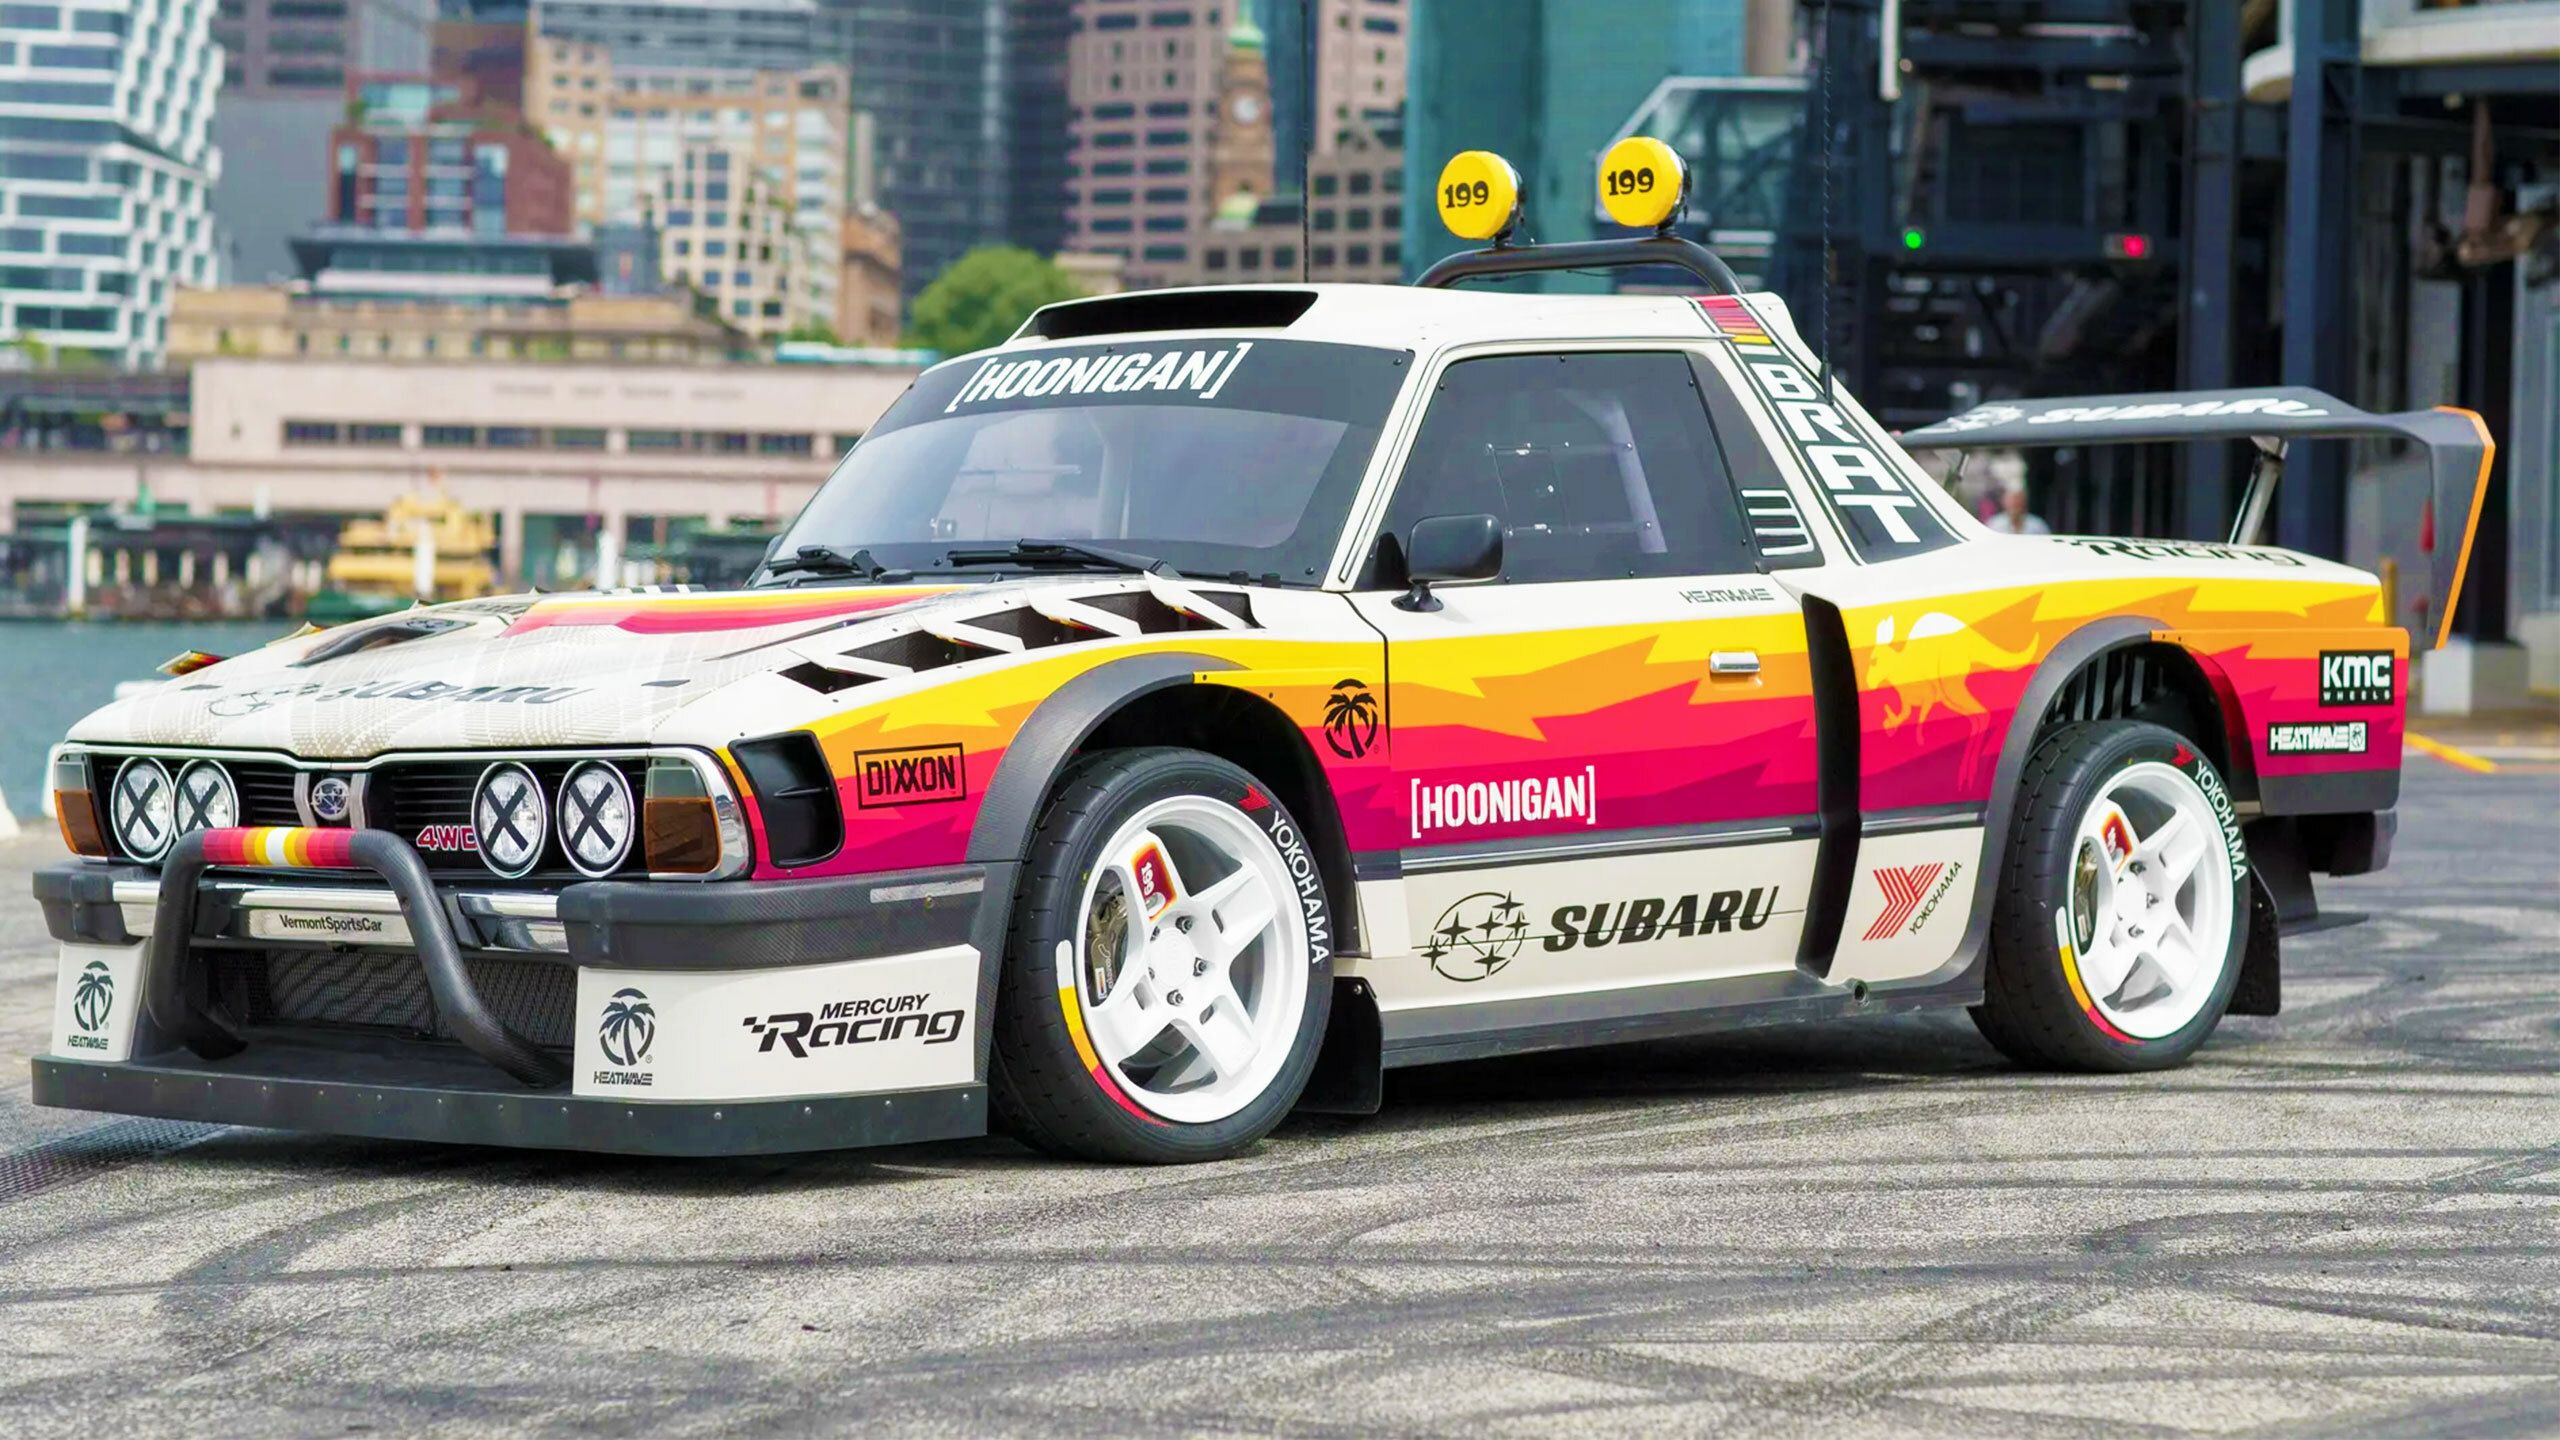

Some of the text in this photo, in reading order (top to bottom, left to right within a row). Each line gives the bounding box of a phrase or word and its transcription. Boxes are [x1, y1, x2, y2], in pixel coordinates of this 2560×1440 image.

[1445, 180, 1489, 209] 199
[1608, 167, 1654, 196] 199
[1750, 362, 1921, 543] BRAT
[1678, 588, 1775, 604] HEATWAVE
[2323, 655, 2391, 688] KMC
[2270, 725, 2350, 751] HEATWAVE
[866, 754, 956, 796] DIXXON
[2194, 759, 2248, 882] YOKOHAMA
[1268, 810, 1330, 964] YOKOHAMA
[1909, 861, 1962, 935] YOKOHAMA
[1543, 885, 1780, 953] SUBARU
[819, 993, 930, 1020] MERCURY
[757, 1010, 965, 1059] Racing
[593, 1070, 653, 1086] HEATWAVE
